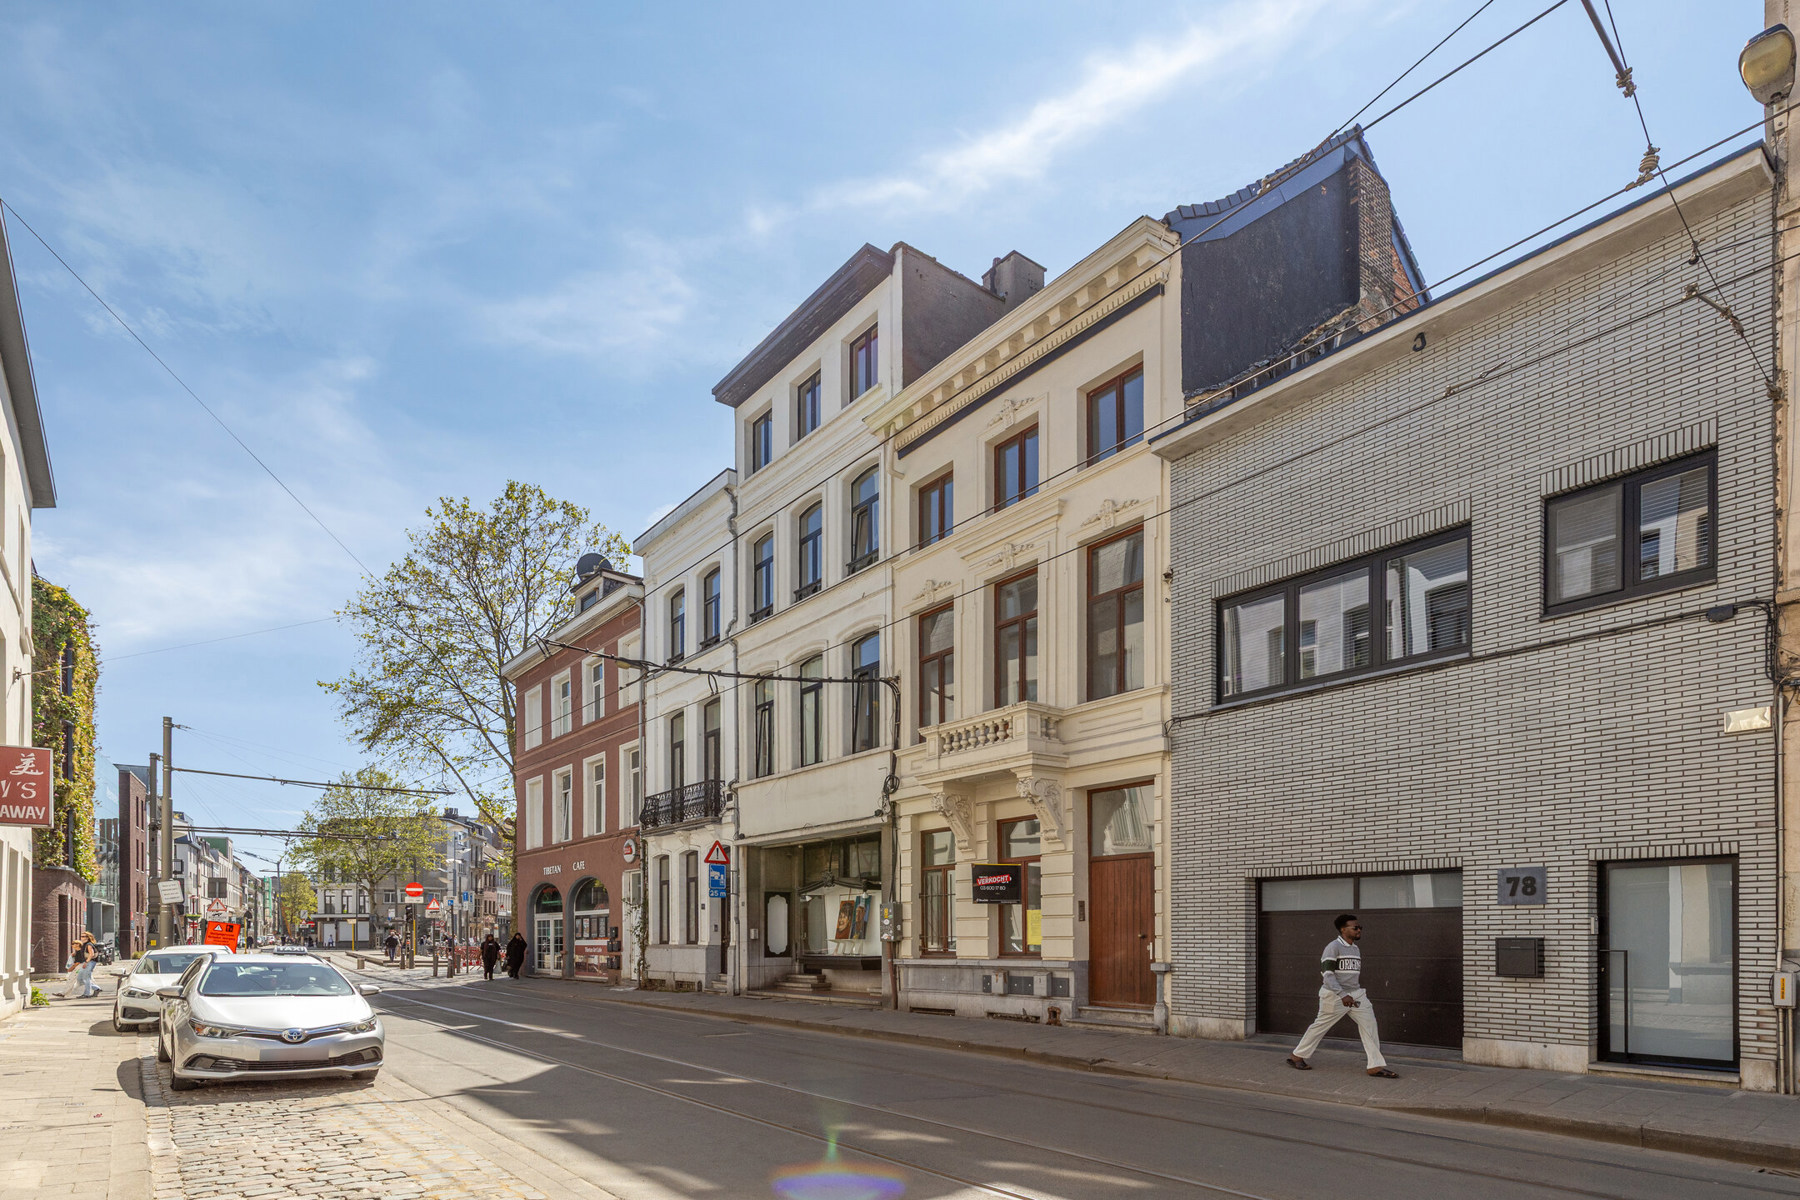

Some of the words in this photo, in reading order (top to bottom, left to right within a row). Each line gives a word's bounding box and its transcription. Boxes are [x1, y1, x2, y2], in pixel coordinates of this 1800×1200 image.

[0, 804, 46, 819] AWAY
[543, 865, 562, 875] TIBETAN
[977, 875, 1009, 885] VERKOCHT
[1506, 876, 1537, 896] 78
